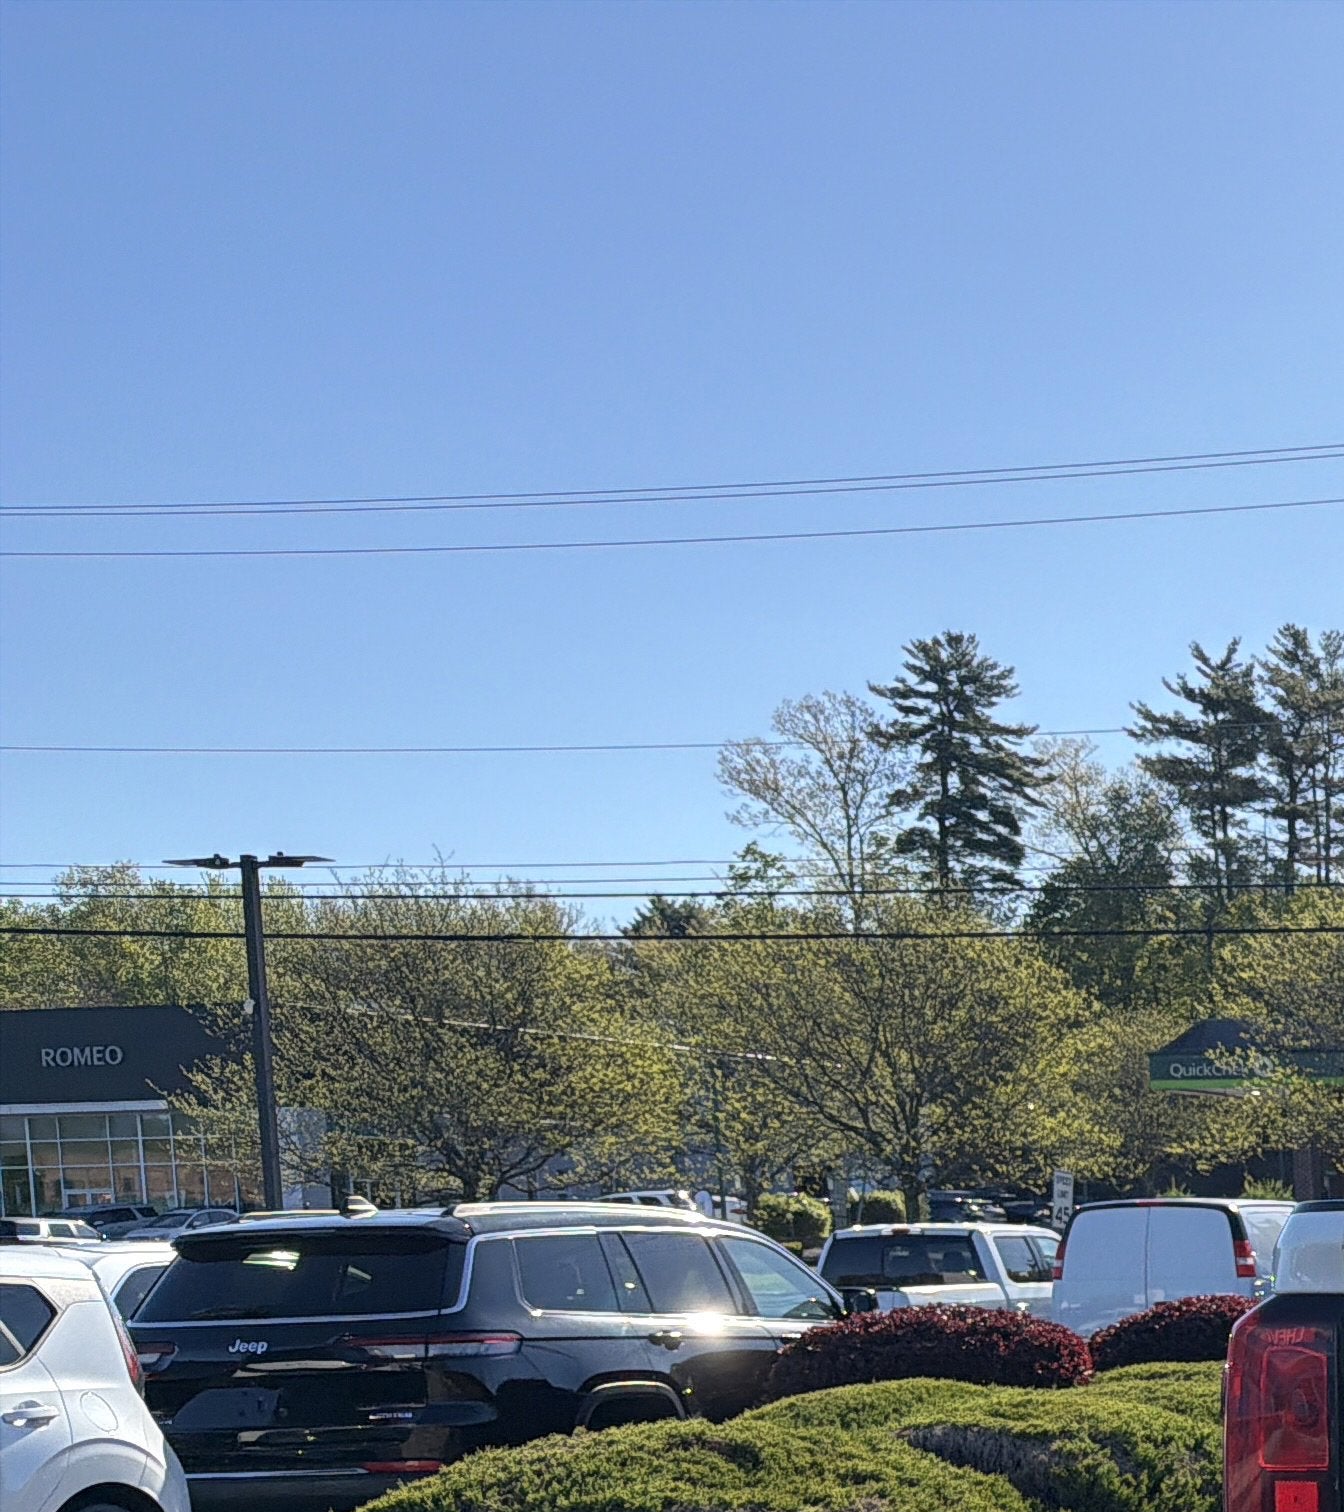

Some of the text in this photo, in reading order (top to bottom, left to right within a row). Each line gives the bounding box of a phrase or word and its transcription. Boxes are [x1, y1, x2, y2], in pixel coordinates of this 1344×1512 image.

[41, 1045, 123, 1067] ROMEO
[1055, 1206, 1070, 1225] 45
[228, 1338, 268, 1355] Jeep
